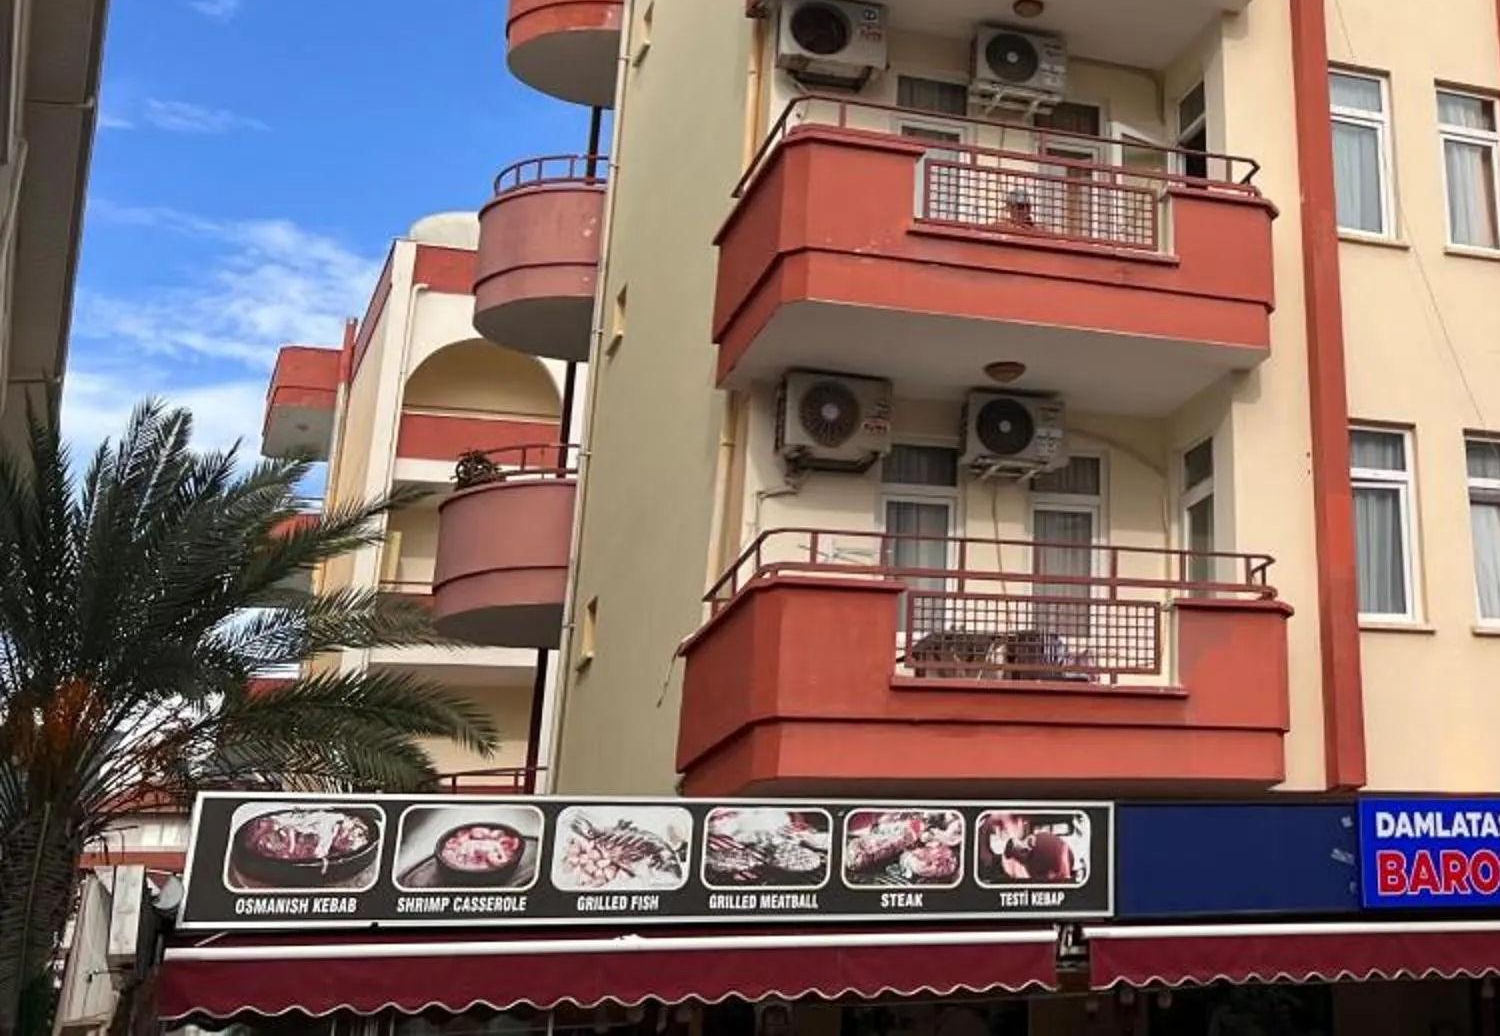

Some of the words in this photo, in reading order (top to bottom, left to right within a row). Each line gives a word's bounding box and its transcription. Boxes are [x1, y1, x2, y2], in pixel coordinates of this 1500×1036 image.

[235, 897, 309, 914] OSMANISH
[312, 897, 357, 913] KEBAB
[396, 896, 450, 913] SHRIMP
[453, 896, 528, 912] CASSEROLE
[577, 895, 628, 911] GRILLED
[630, 895, 660, 911] FISH
[708, 894, 757, 910] GRILLED
[760, 893, 819, 909] MEATBALL
[880, 893, 923, 908] STEAK
[1000, 890, 1029, 907] TESTİ
[1031, 891, 1065, 906] KEBAP
